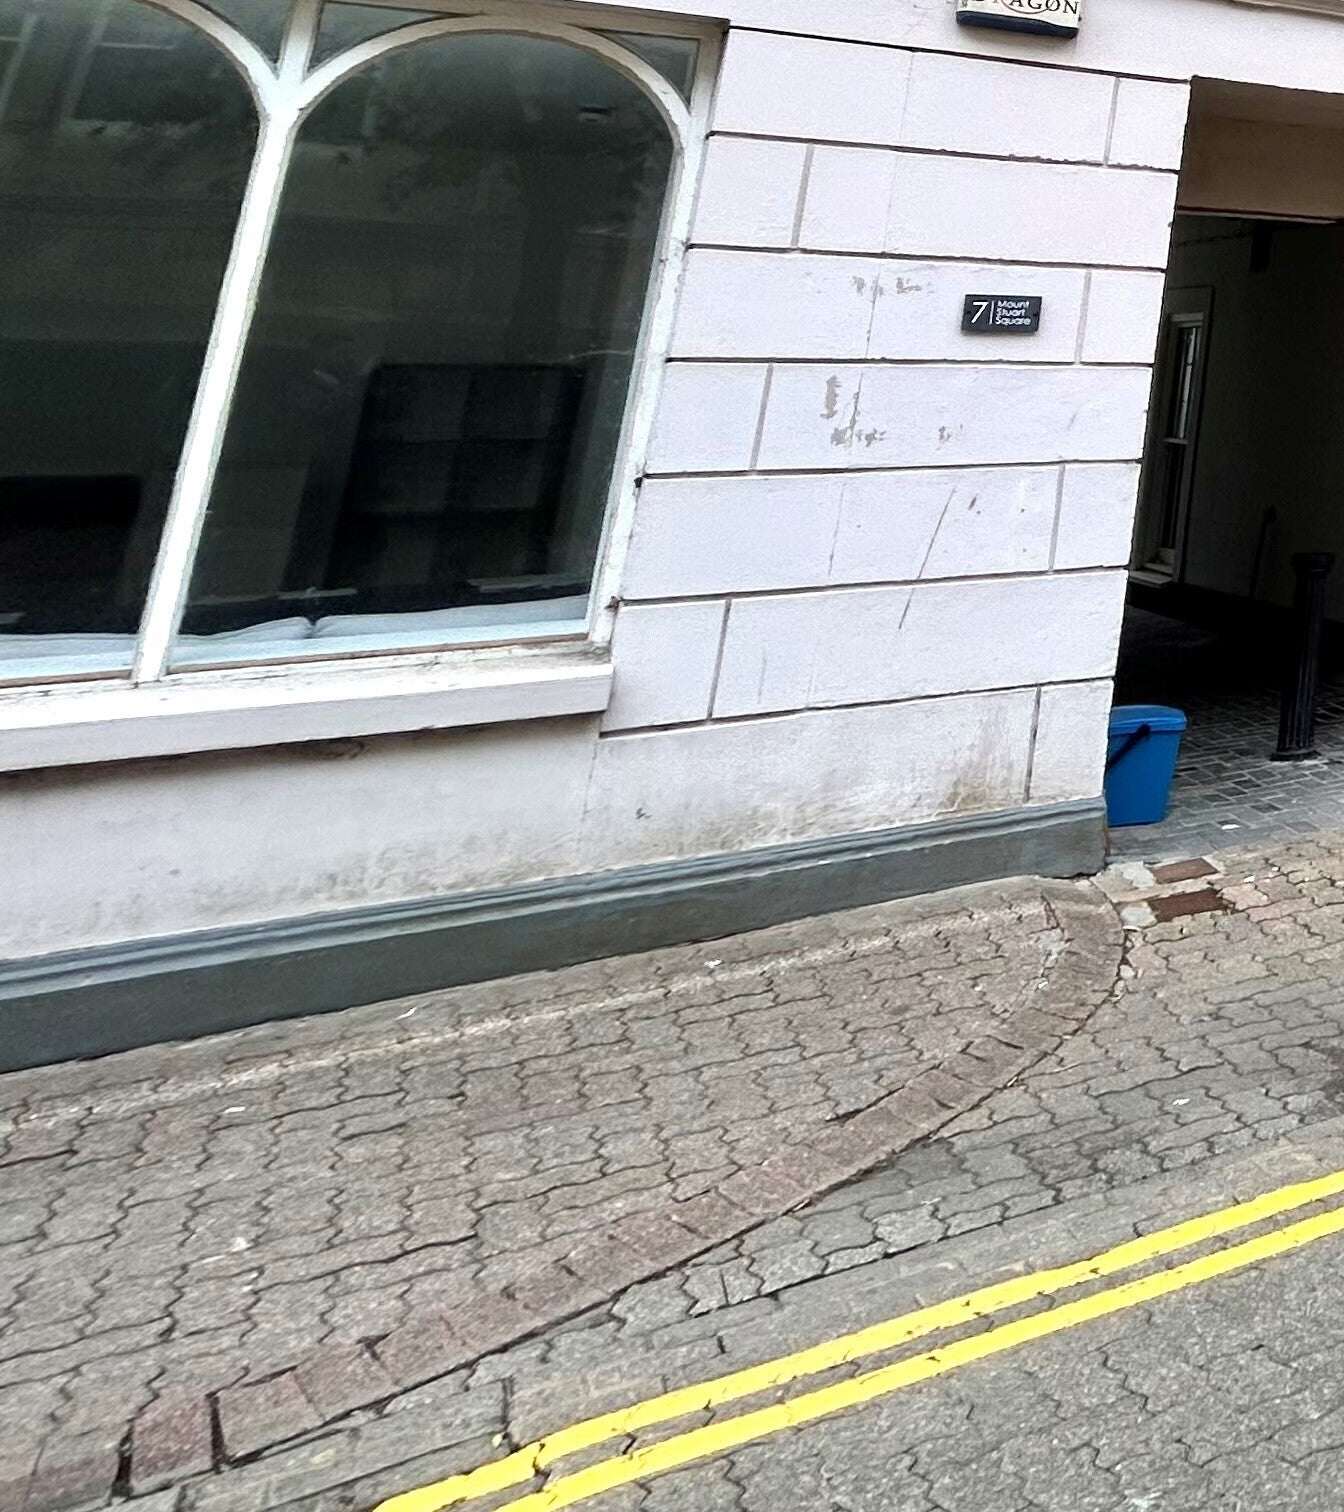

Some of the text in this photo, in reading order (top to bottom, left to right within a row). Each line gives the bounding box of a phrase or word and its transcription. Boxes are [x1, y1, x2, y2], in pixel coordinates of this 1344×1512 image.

[997, 300, 1030, 309] Mount
[971, 301, 989, 324] 7
[996, 308, 1026, 317] Stuart
[995, 317, 1032, 326] Square
